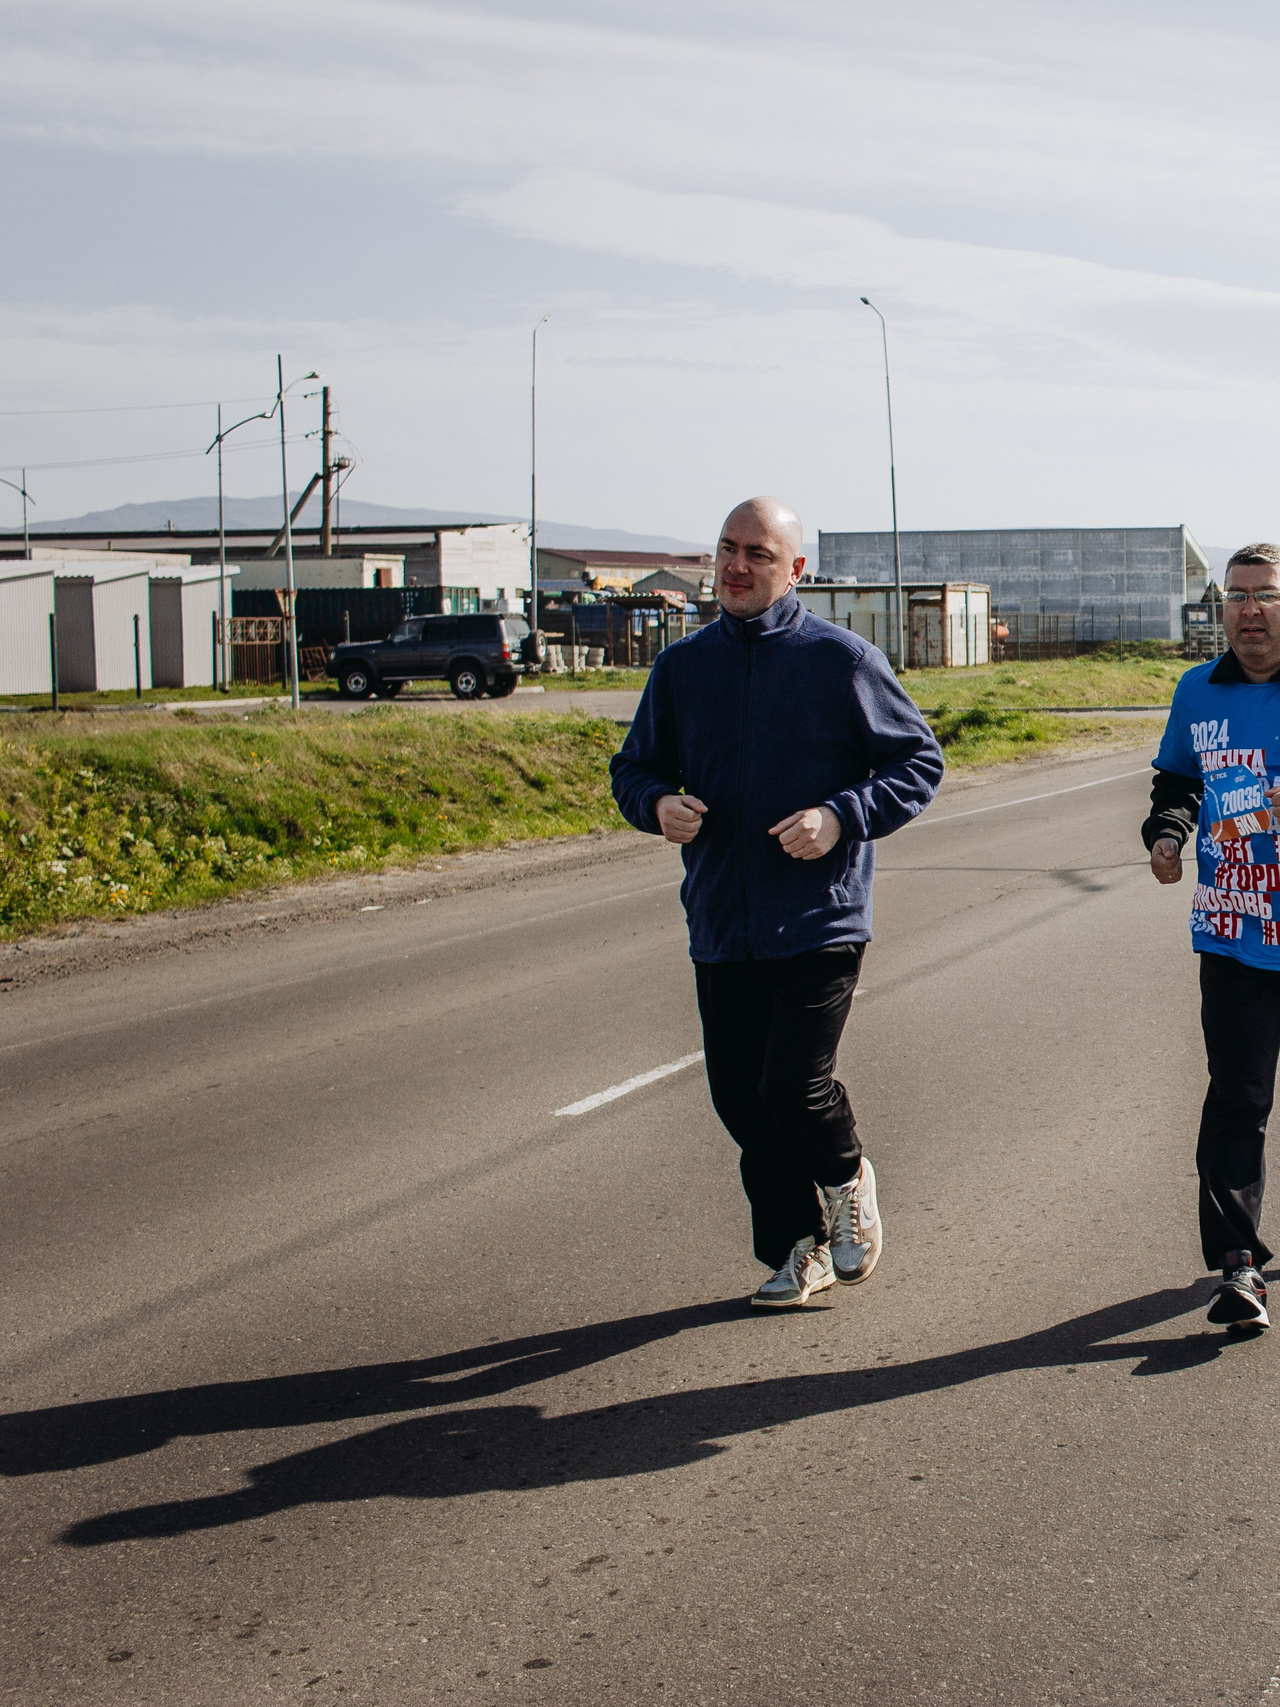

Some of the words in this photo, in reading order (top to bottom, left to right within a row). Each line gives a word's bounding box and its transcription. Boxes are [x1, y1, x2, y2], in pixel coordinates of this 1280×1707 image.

[1190, 718, 1230, 753] 2024
[1221, 784, 1261, 816] 20035
[1233, 812, 1264, 837] 5КМ
